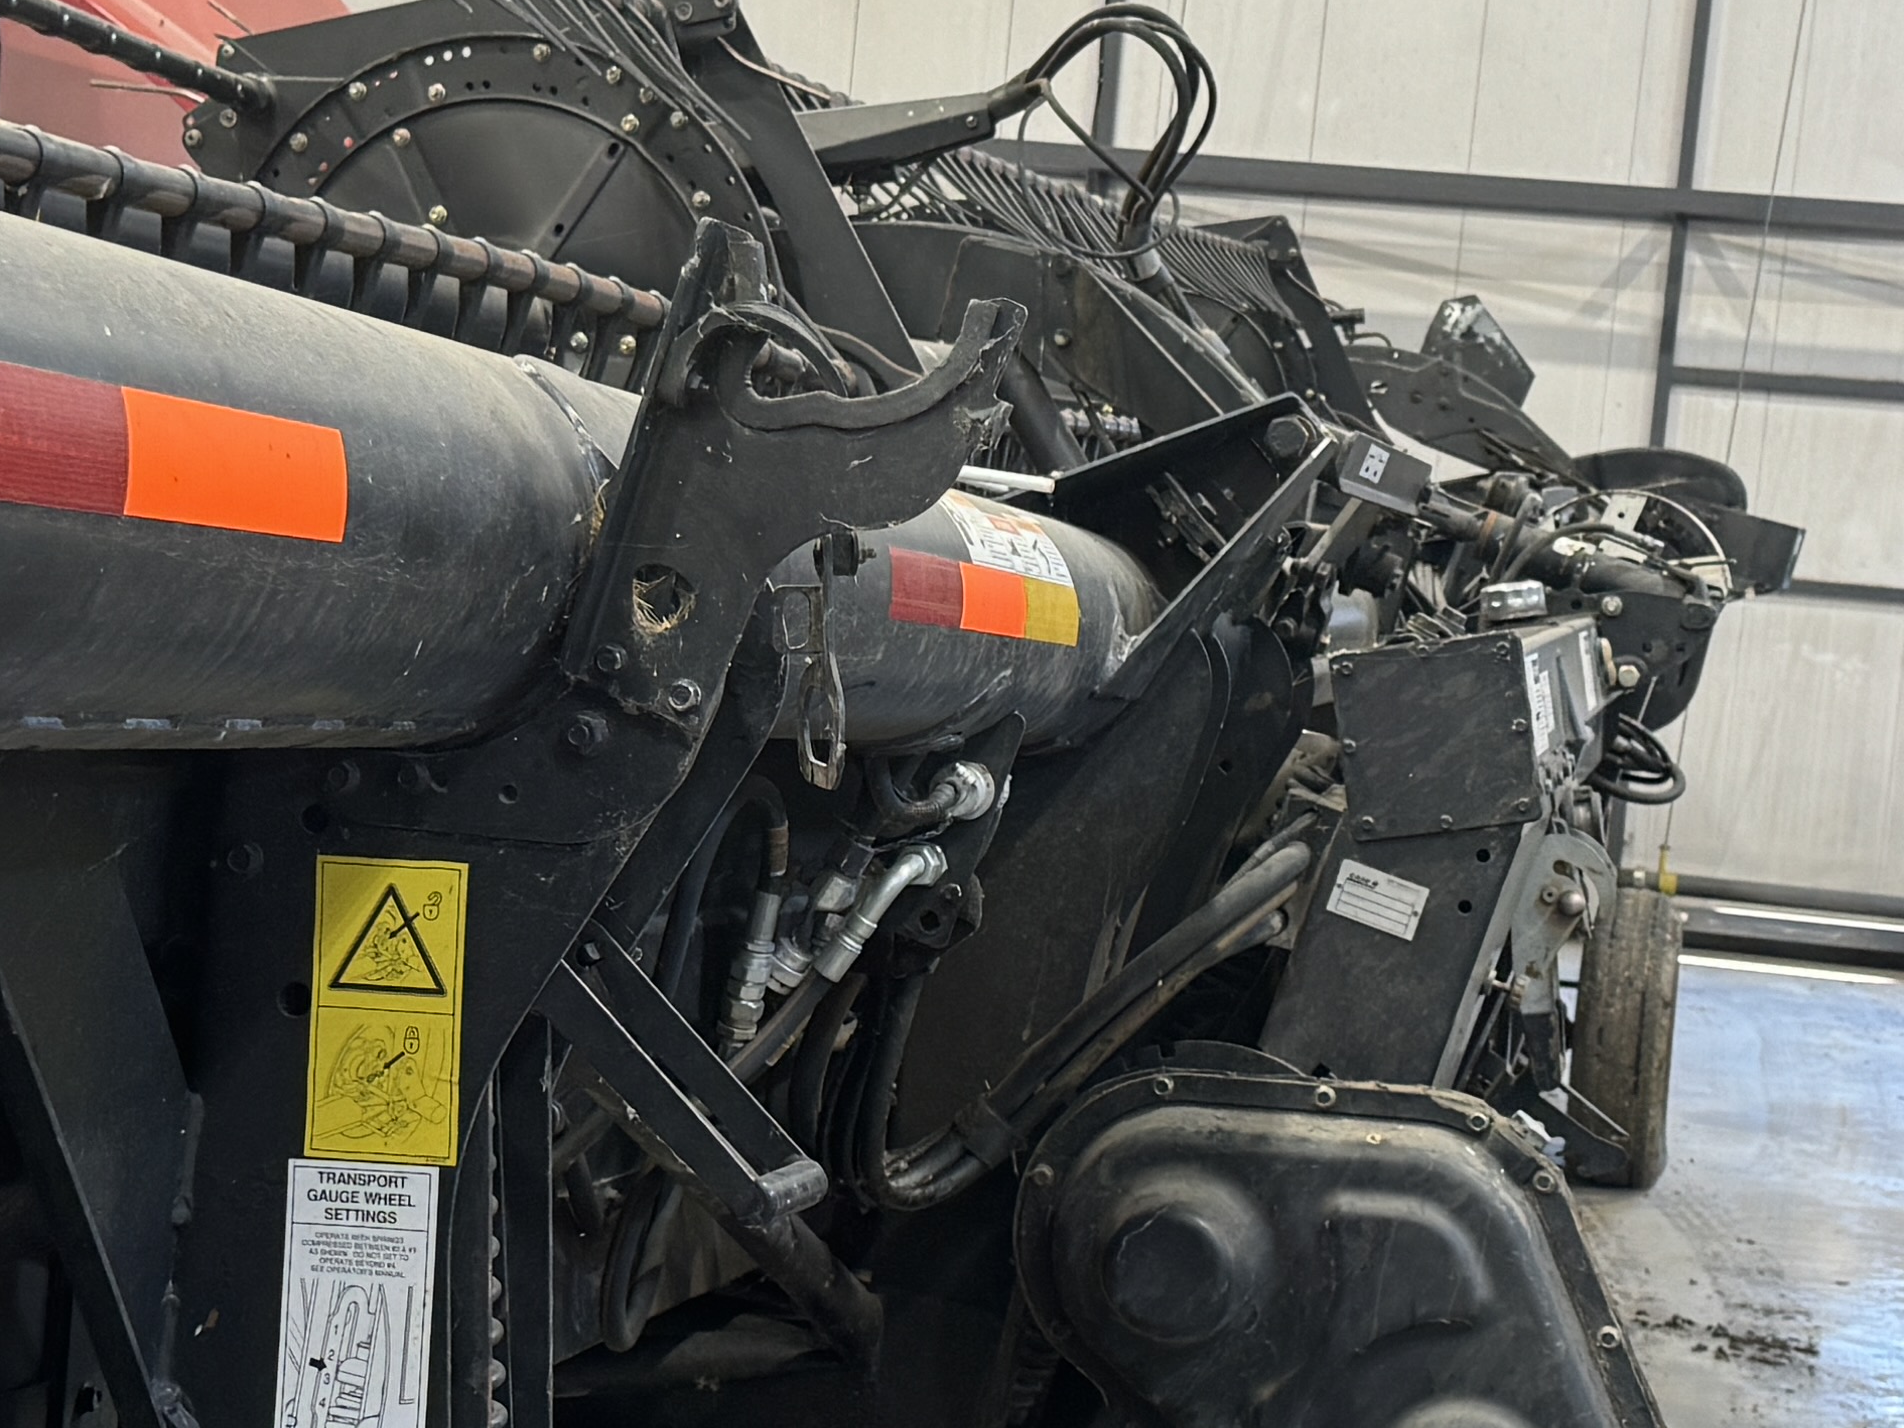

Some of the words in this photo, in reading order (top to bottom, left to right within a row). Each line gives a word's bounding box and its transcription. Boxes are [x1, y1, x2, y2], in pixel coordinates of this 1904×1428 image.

[317, 1171, 408, 1189] TRANSPORT
[307, 1188, 360, 1204] GAUGE
[364, 1191, 416, 1208] WHEEL
[324, 1207, 398, 1224] SETTINGS
[319, 1257, 353, 1266] OPERATE
[333, 1324, 339, 1335] 1
[327, 1349, 335, 1361] 2
[323, 1373, 331, 1385] 3
[318, 1397, 327, 1408] 4
